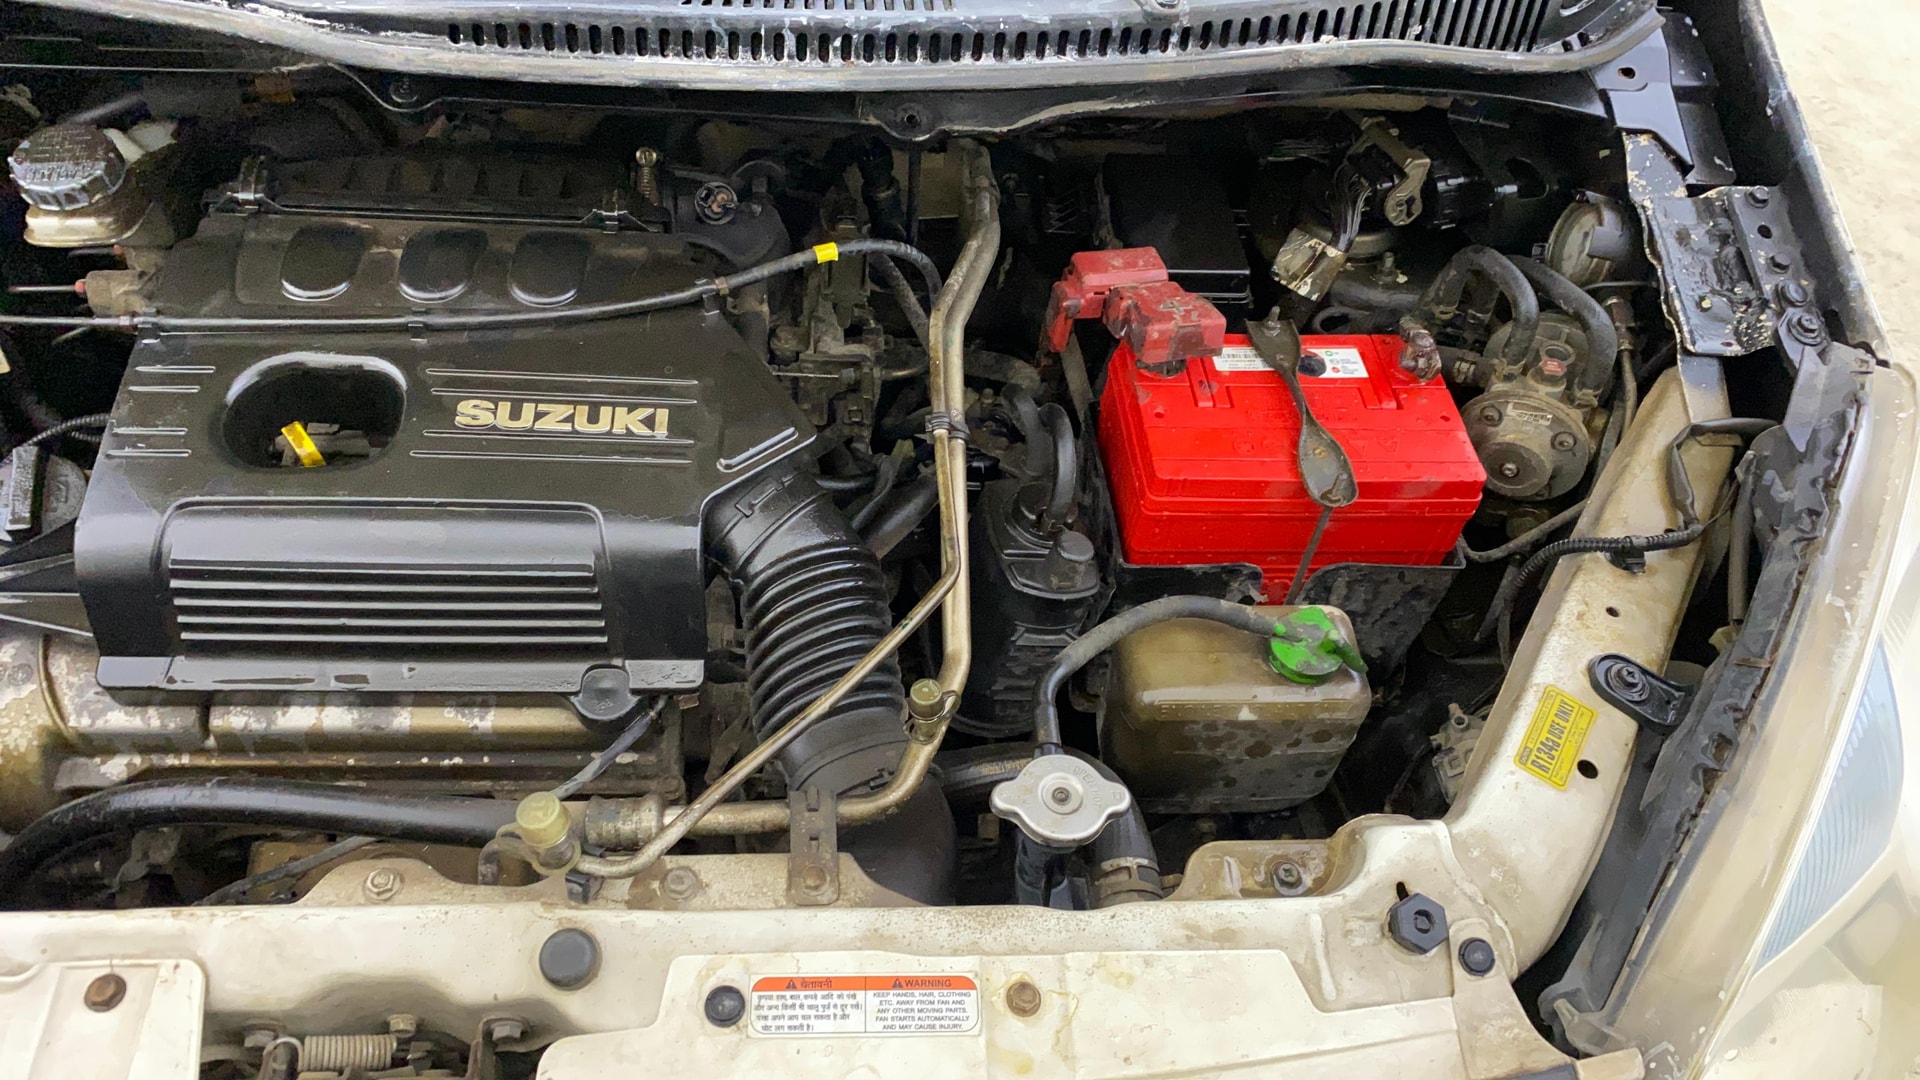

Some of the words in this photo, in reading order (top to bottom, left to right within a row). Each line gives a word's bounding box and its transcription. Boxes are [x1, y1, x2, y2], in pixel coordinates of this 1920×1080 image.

[454, 399, 669, 436] SUZUKI
[1553, 698, 1575, 723] ONLY
[1546, 719, 1566, 740] USE
[1530, 734, 1561, 774] R134a
[905, 979, 951, 987] WARNING
